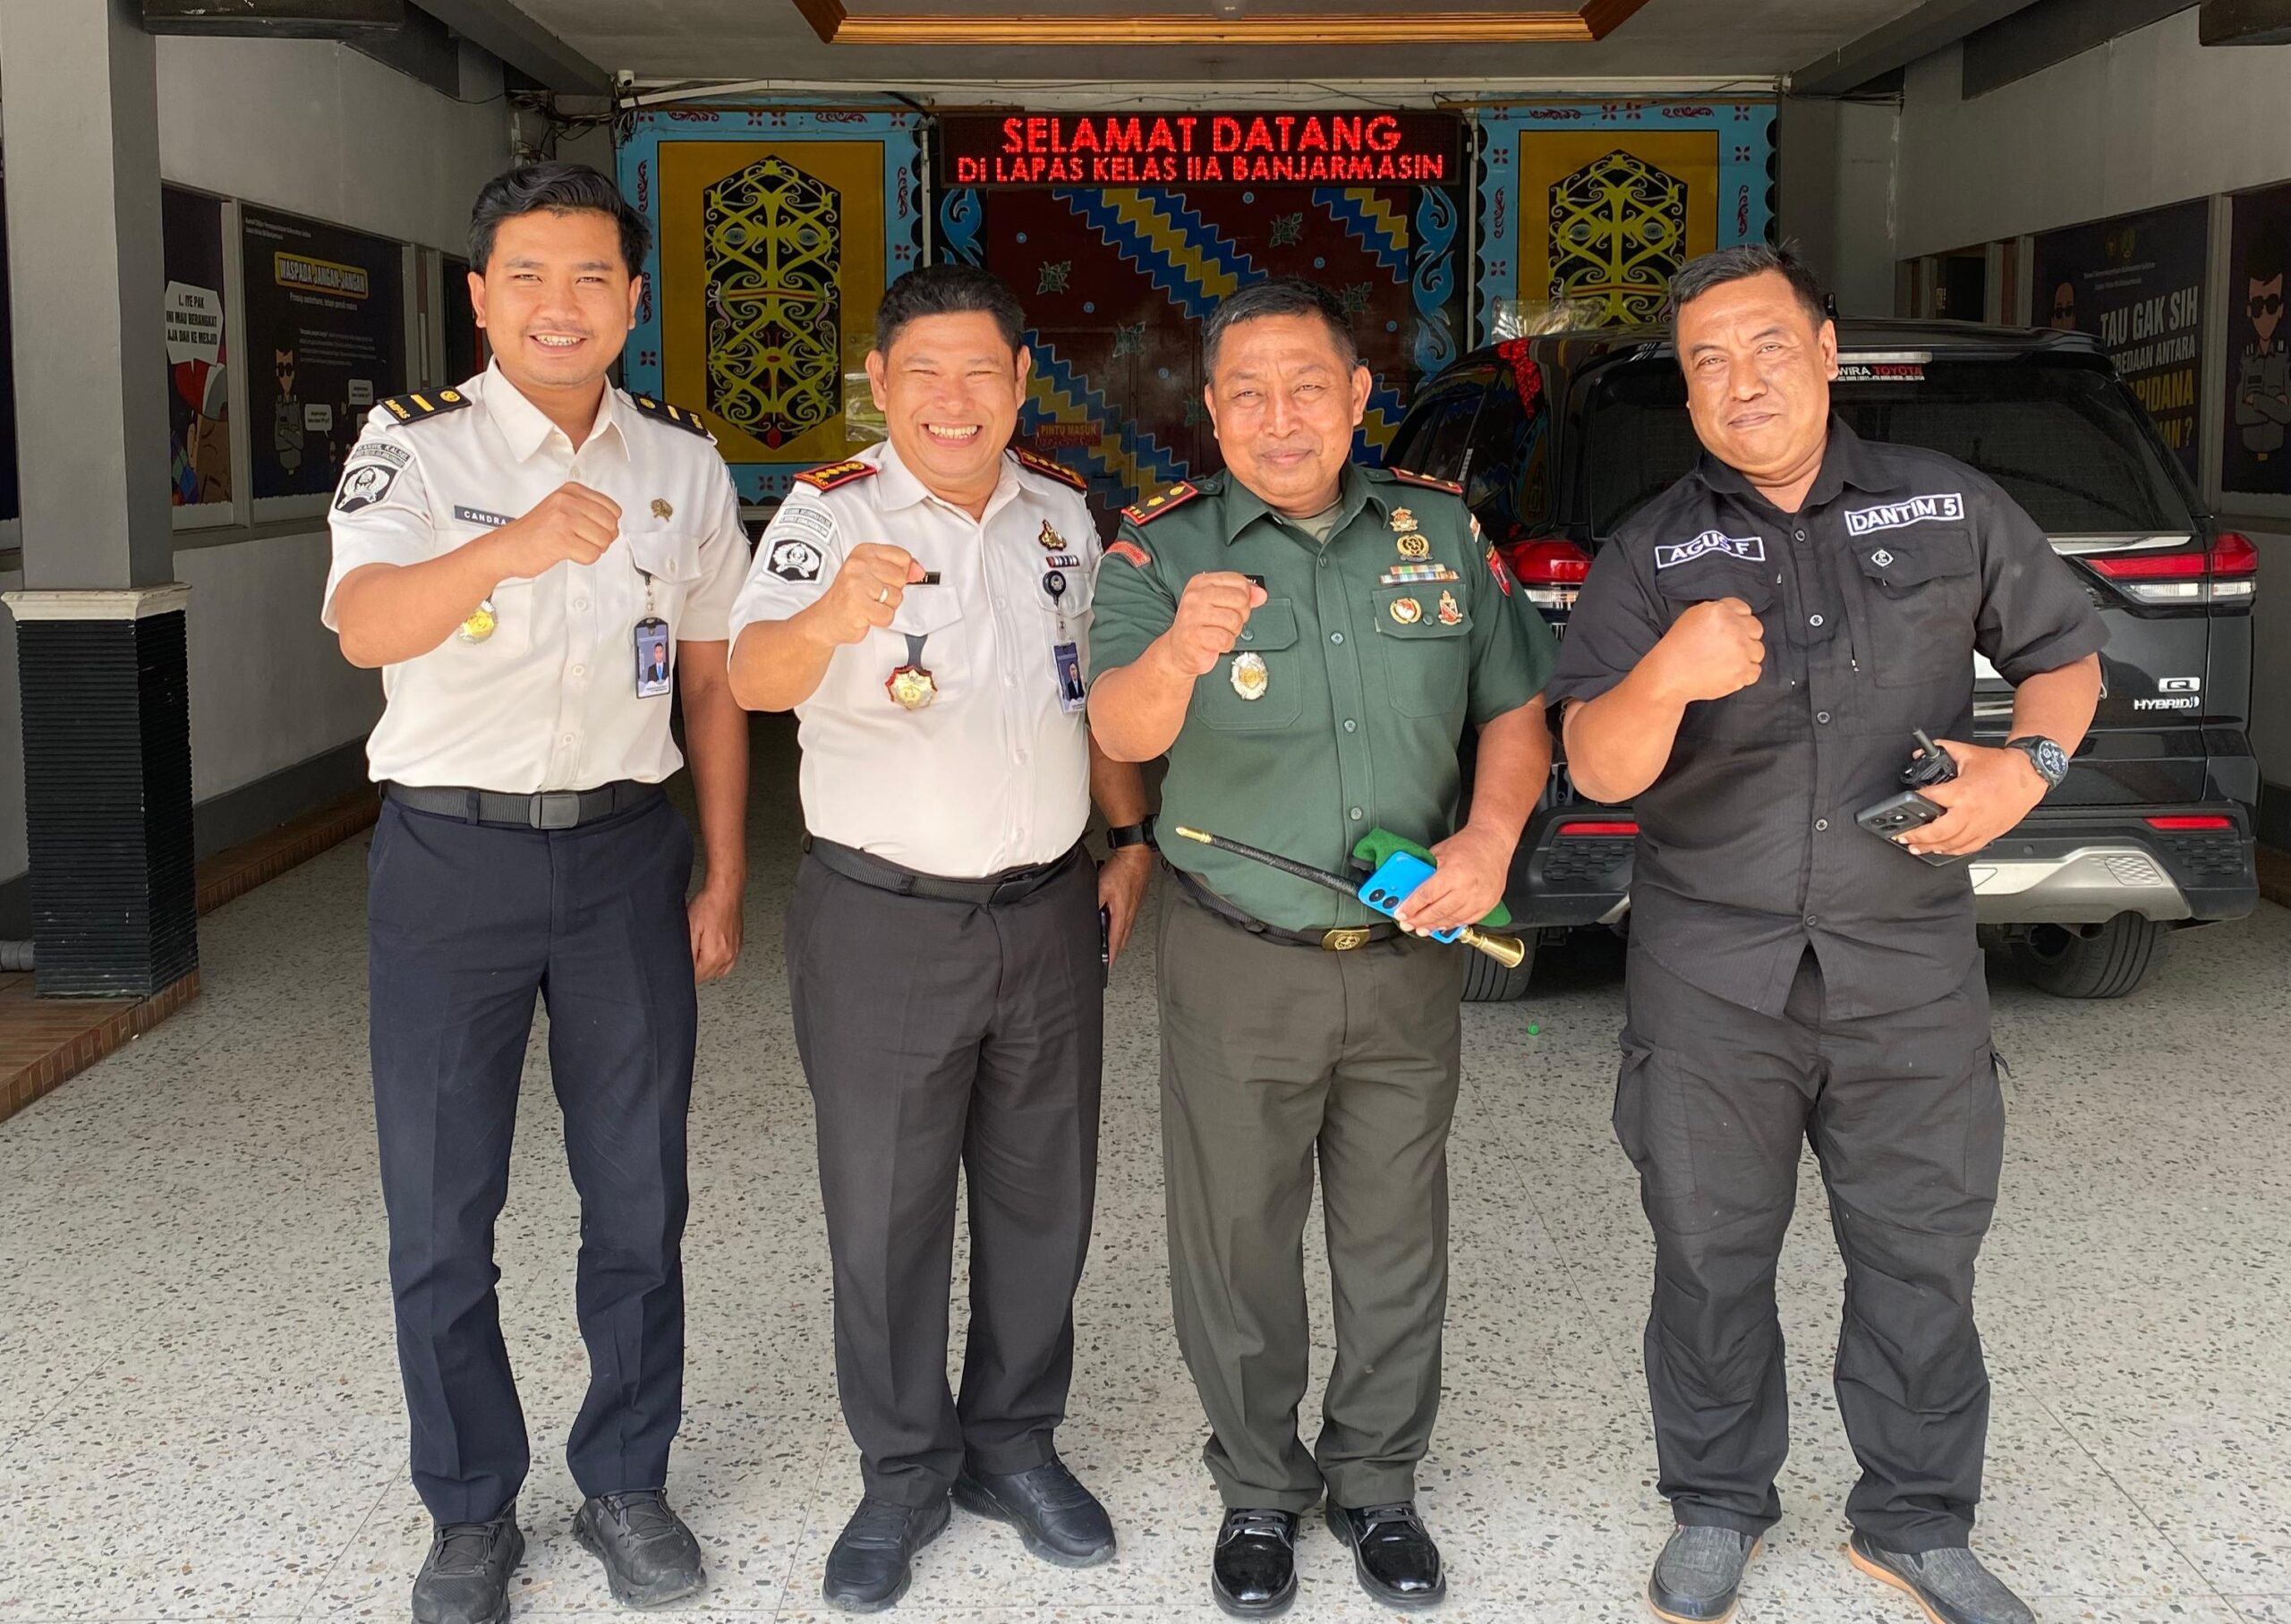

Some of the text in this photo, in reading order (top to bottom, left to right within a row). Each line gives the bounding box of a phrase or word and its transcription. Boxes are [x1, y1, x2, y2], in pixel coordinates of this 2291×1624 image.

[1002, 116, 1401, 152] SELAMAT DATANG
[996, 156, 1083, 182] LAPAS
[1093, 156, 1177, 182] KELAS
[1187, 156, 1222, 181] IIA
[1232, 155, 1443, 181] BANJARMASIN
[278, 259, 313, 284] WASPADA
[188, 313, 217, 327] BERANGKAT
[2099, 285, 2199, 347] TAU GAK SIH
[167, 328, 178, 342] AJA
[191, 331, 198, 344] KE
[2155, 335, 2196, 366] ANTARA
[1872, 365, 1923, 376] TOYOTA
[1041, 423, 1096, 435] PINTU MASUK
[464, 511, 507, 526] CANDRA
[1851, 498, 1957, 531] DANTIM 5
[1670, 533, 1750, 562] AGUS F
[2133, 698, 2190, 710] HYBRID
